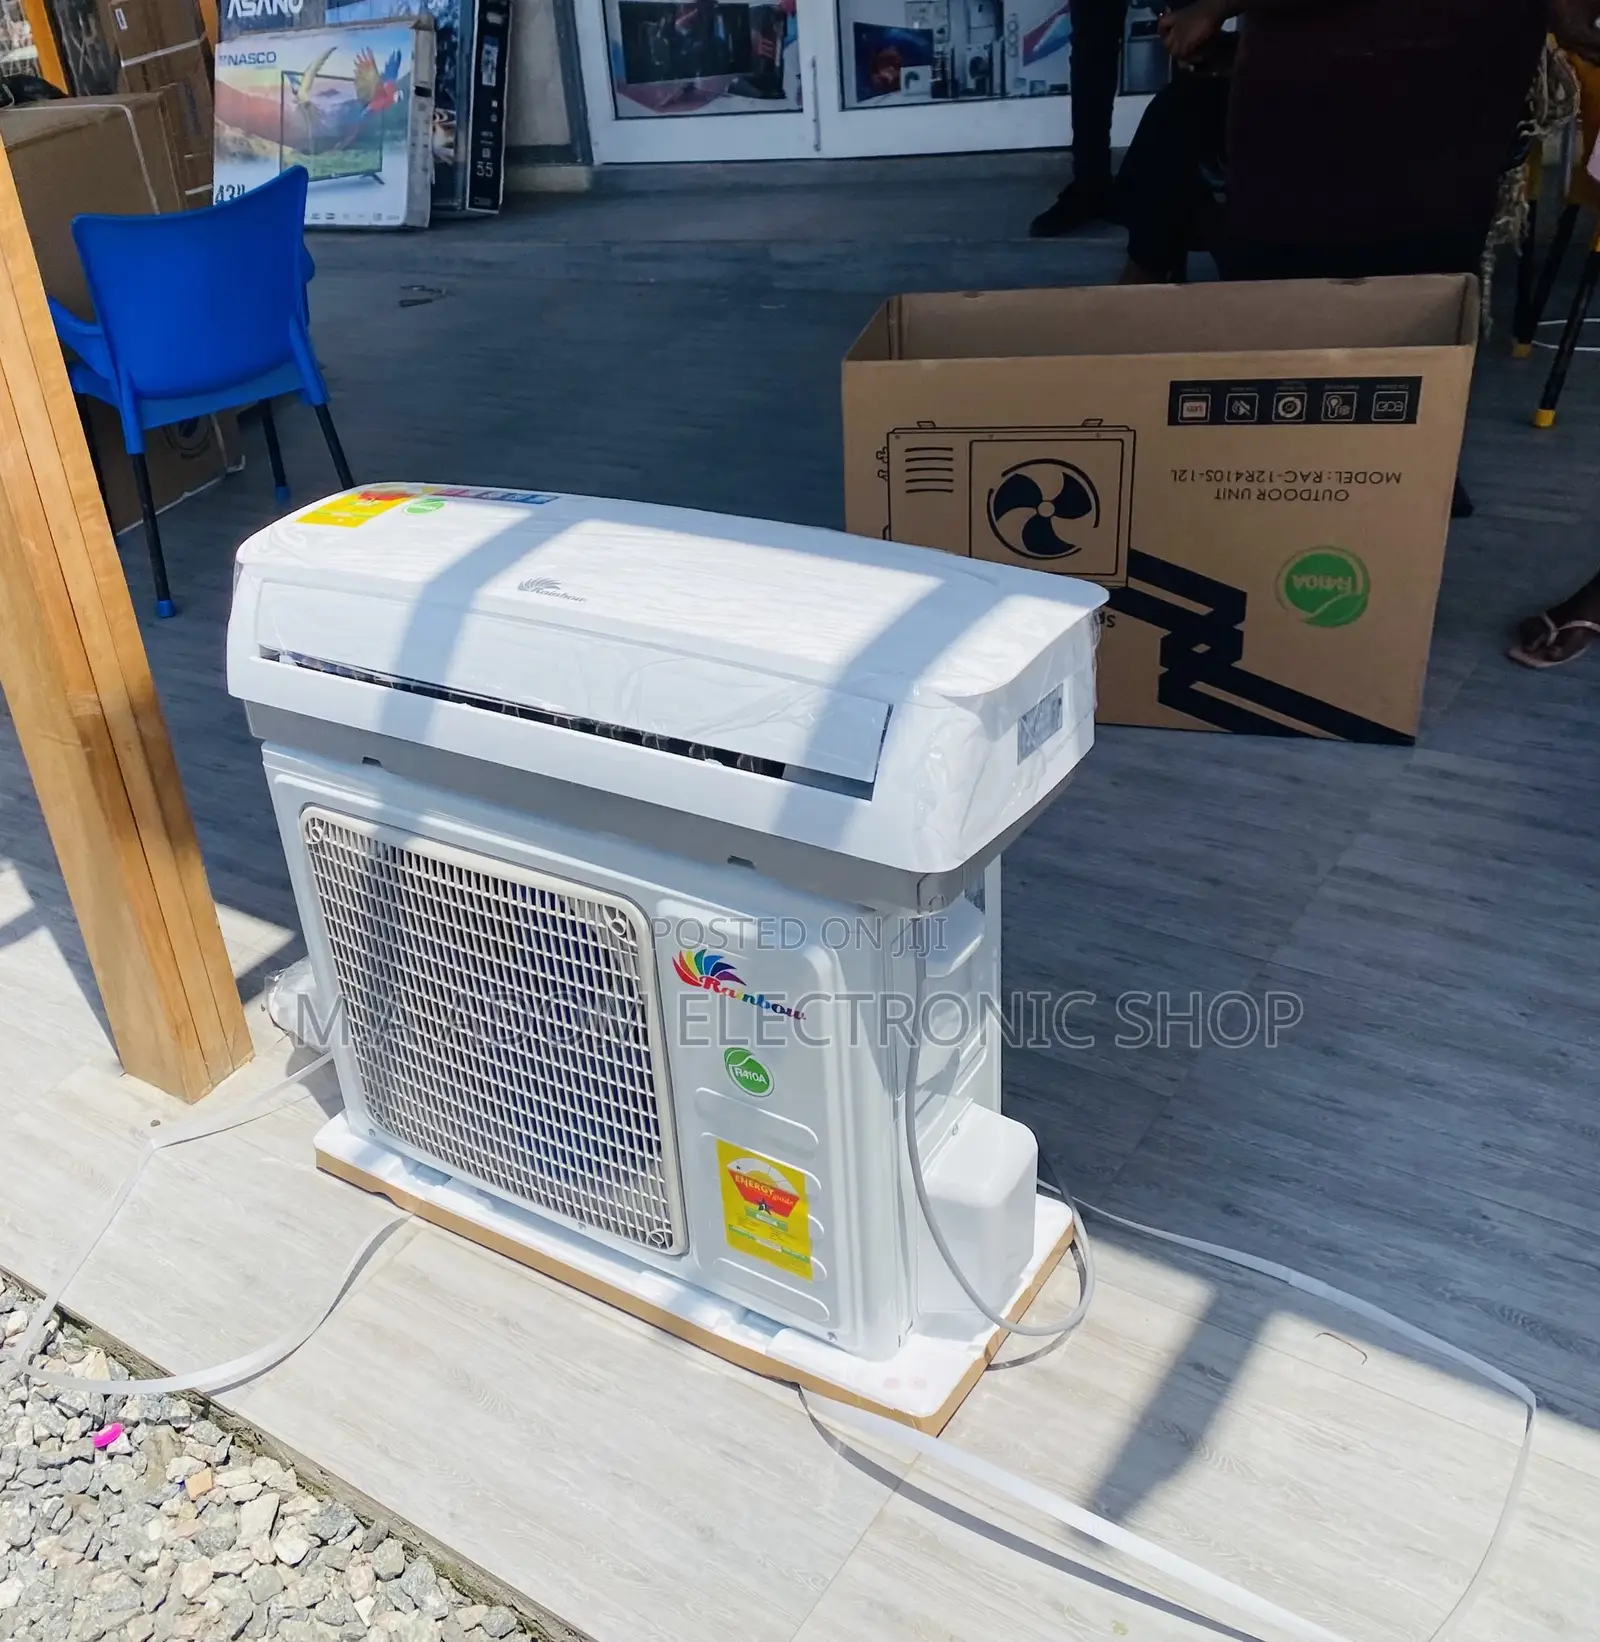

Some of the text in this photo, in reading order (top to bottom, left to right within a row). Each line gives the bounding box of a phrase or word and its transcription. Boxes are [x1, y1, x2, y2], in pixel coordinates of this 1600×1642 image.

[228, 51, 277, 66] NASCO
[476, 161, 494, 177] 55
[1214, 488, 1349, 501] OUTDOOR UNIT
[698, 975, 806, 1020] Rainbow
[734, 1067, 768, 1085] R410A
[735, 1174, 775, 1196] ENERGY
